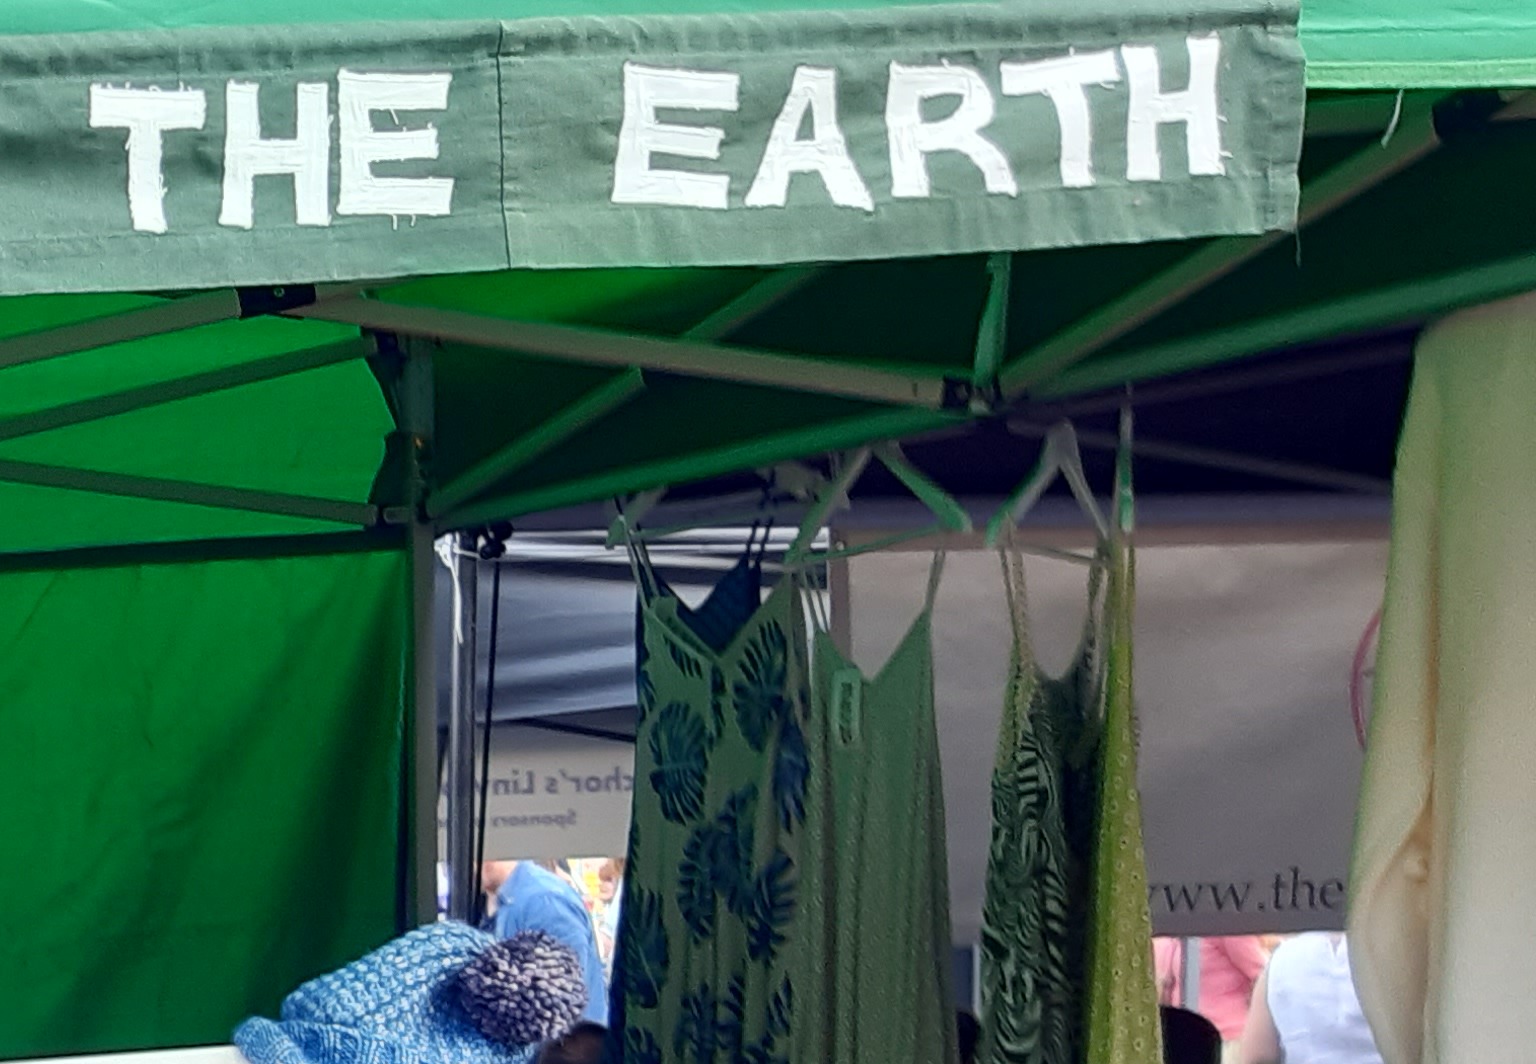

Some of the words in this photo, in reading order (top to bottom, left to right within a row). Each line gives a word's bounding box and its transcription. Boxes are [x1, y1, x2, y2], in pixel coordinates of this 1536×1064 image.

[89, 69, 454, 234] THE
[611, 33, 1225, 211] EARTH
[1148, 866, 1345, 912] ww.the
